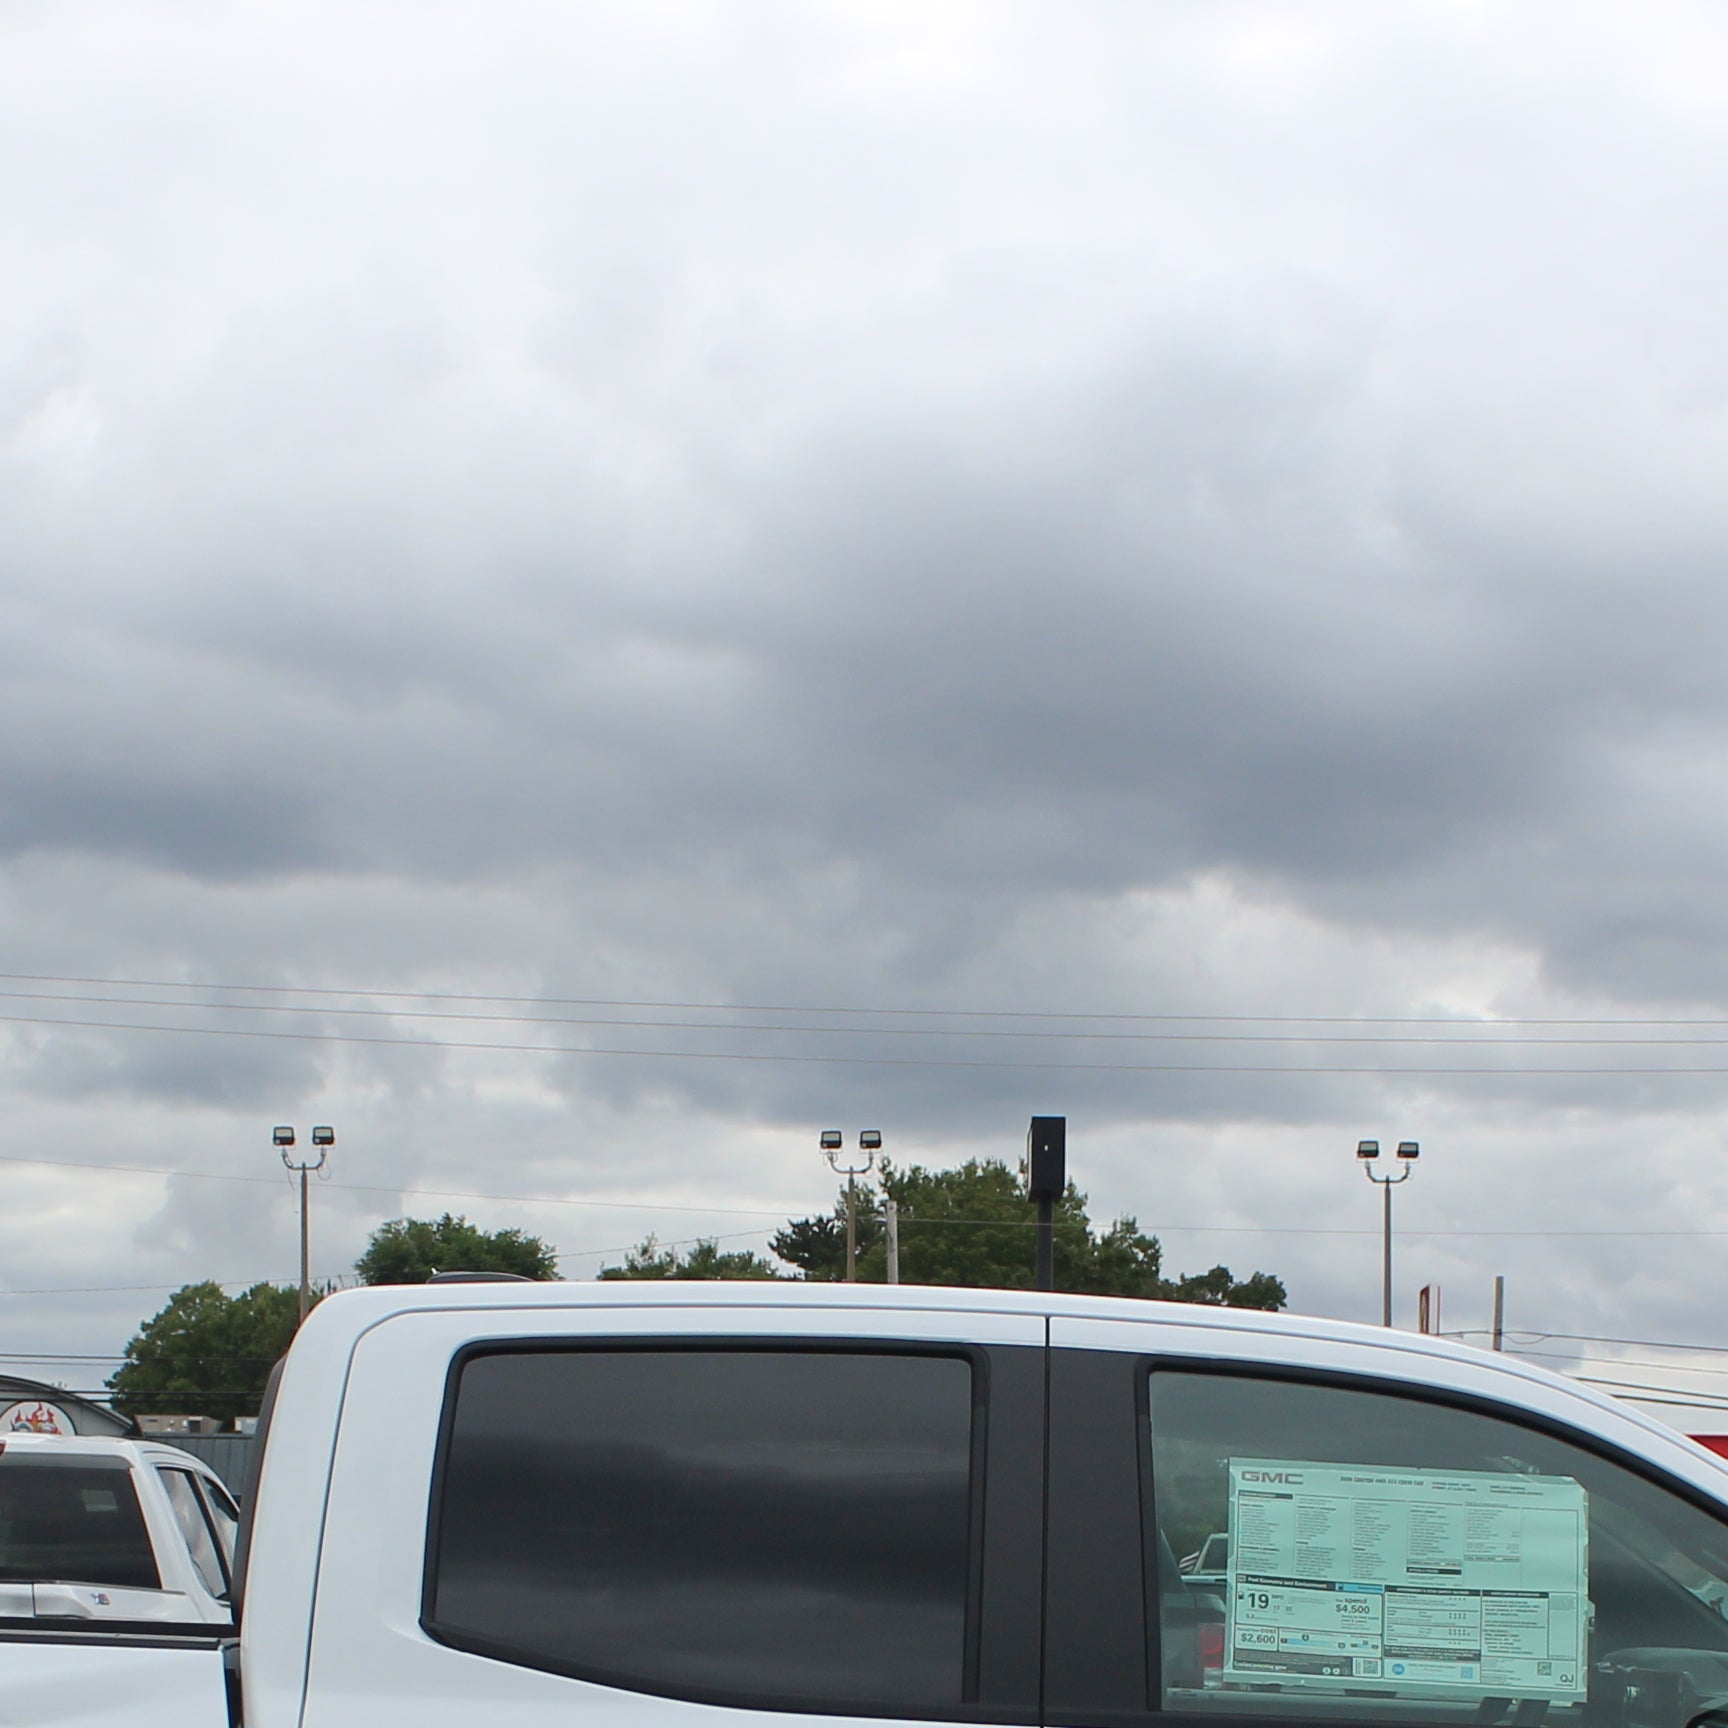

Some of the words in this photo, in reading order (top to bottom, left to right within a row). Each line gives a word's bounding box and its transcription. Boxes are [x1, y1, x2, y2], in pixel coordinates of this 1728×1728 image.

[1241, 1471, 1304, 1485] GMC
[1248, 1592, 1269, 1609] 19
[1335, 1604, 1370, 1614] $4,500
[1240, 1633, 1275, 1643] $2,600
